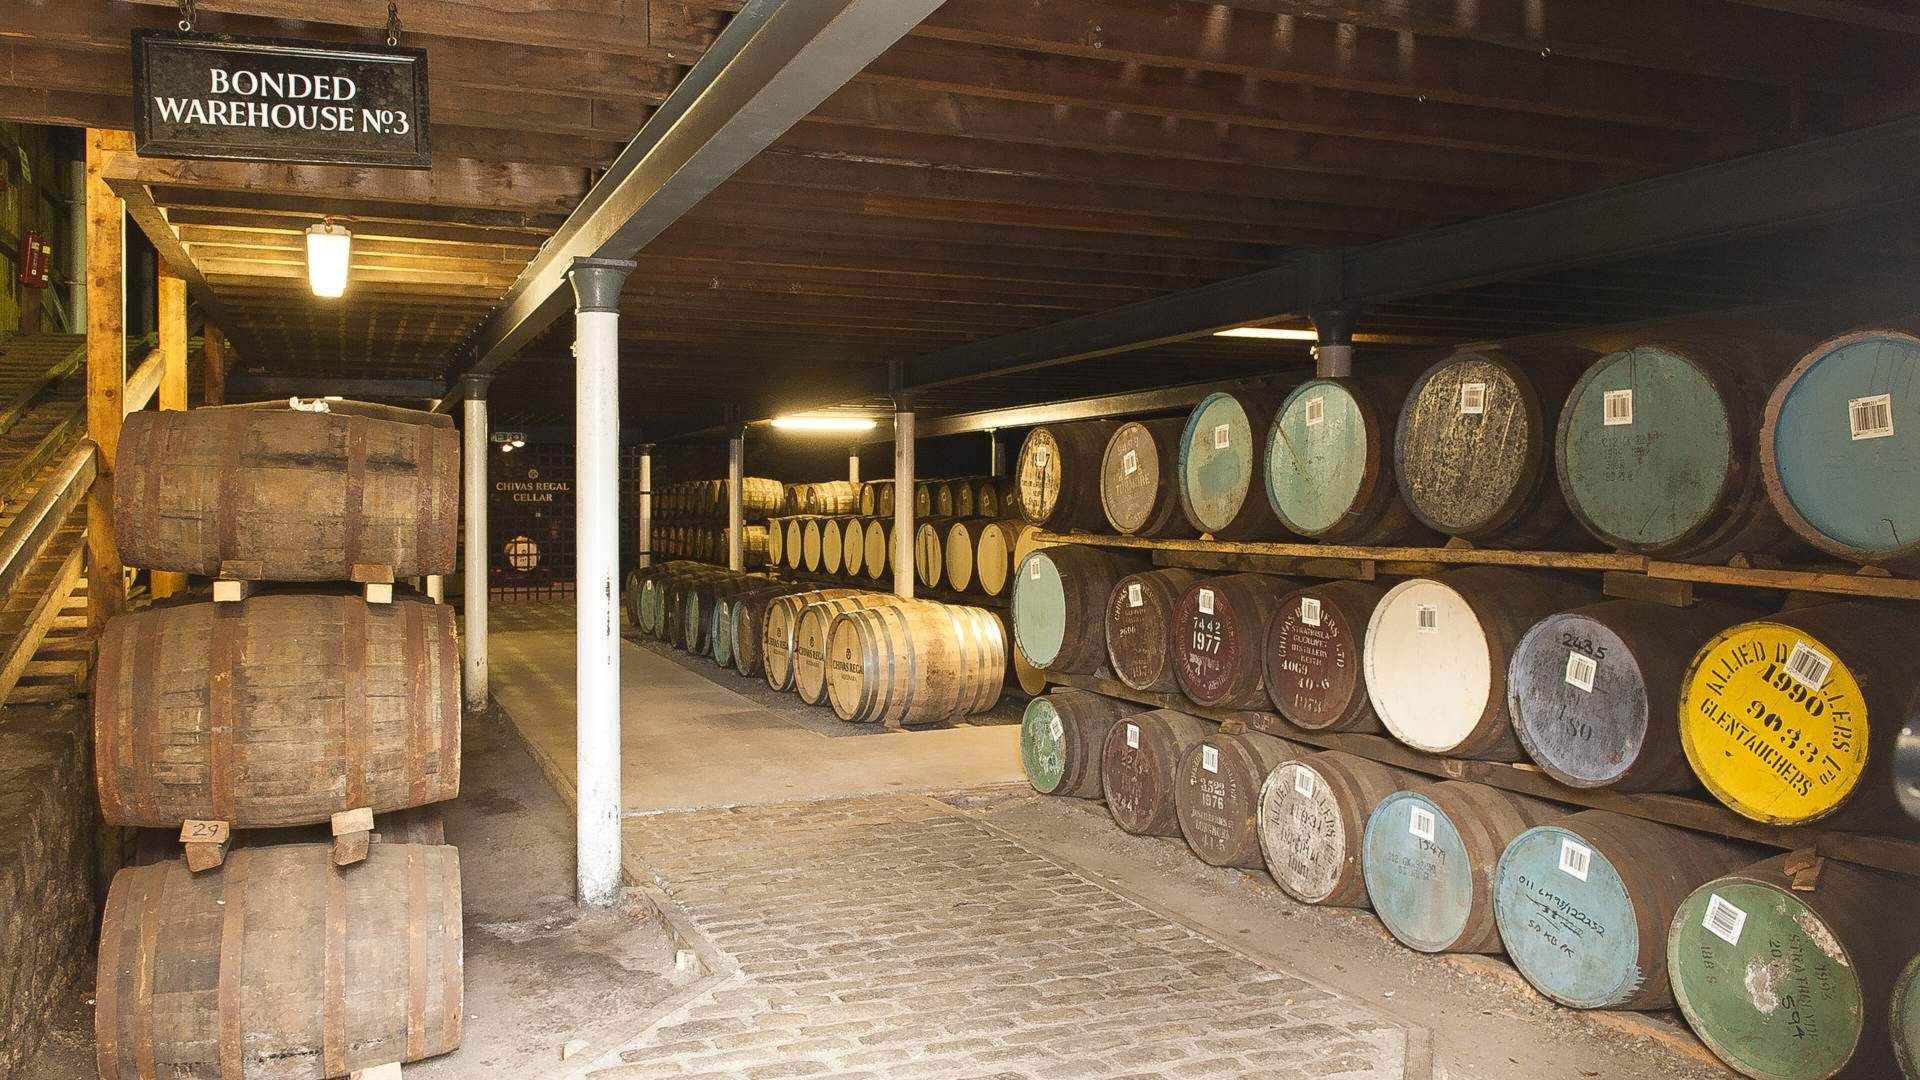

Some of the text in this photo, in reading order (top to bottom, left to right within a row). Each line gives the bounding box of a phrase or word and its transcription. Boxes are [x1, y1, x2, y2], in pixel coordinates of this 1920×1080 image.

[210, 68, 356, 101] BONDED
[154, 96, 355, 132] WAREHOUSE
[496, 482, 570, 491] CHIVAS REGAL
[513, 493, 553, 502] CELLAR
[1193, 617, 1221, 634] 7442
[1192, 631, 1221, 654] 1977
[1562, 633, 1608, 660] 2435
[1706, 641, 1766, 696] ALLIED
[1761, 663, 1824, 717] 1990
[1746, 700, 1819, 763] 9033
[1700, 697, 1813, 797] GLENTAUCHERS
[1202, 793, 1224, 810] 1976
[192, 823, 219, 838] 29
